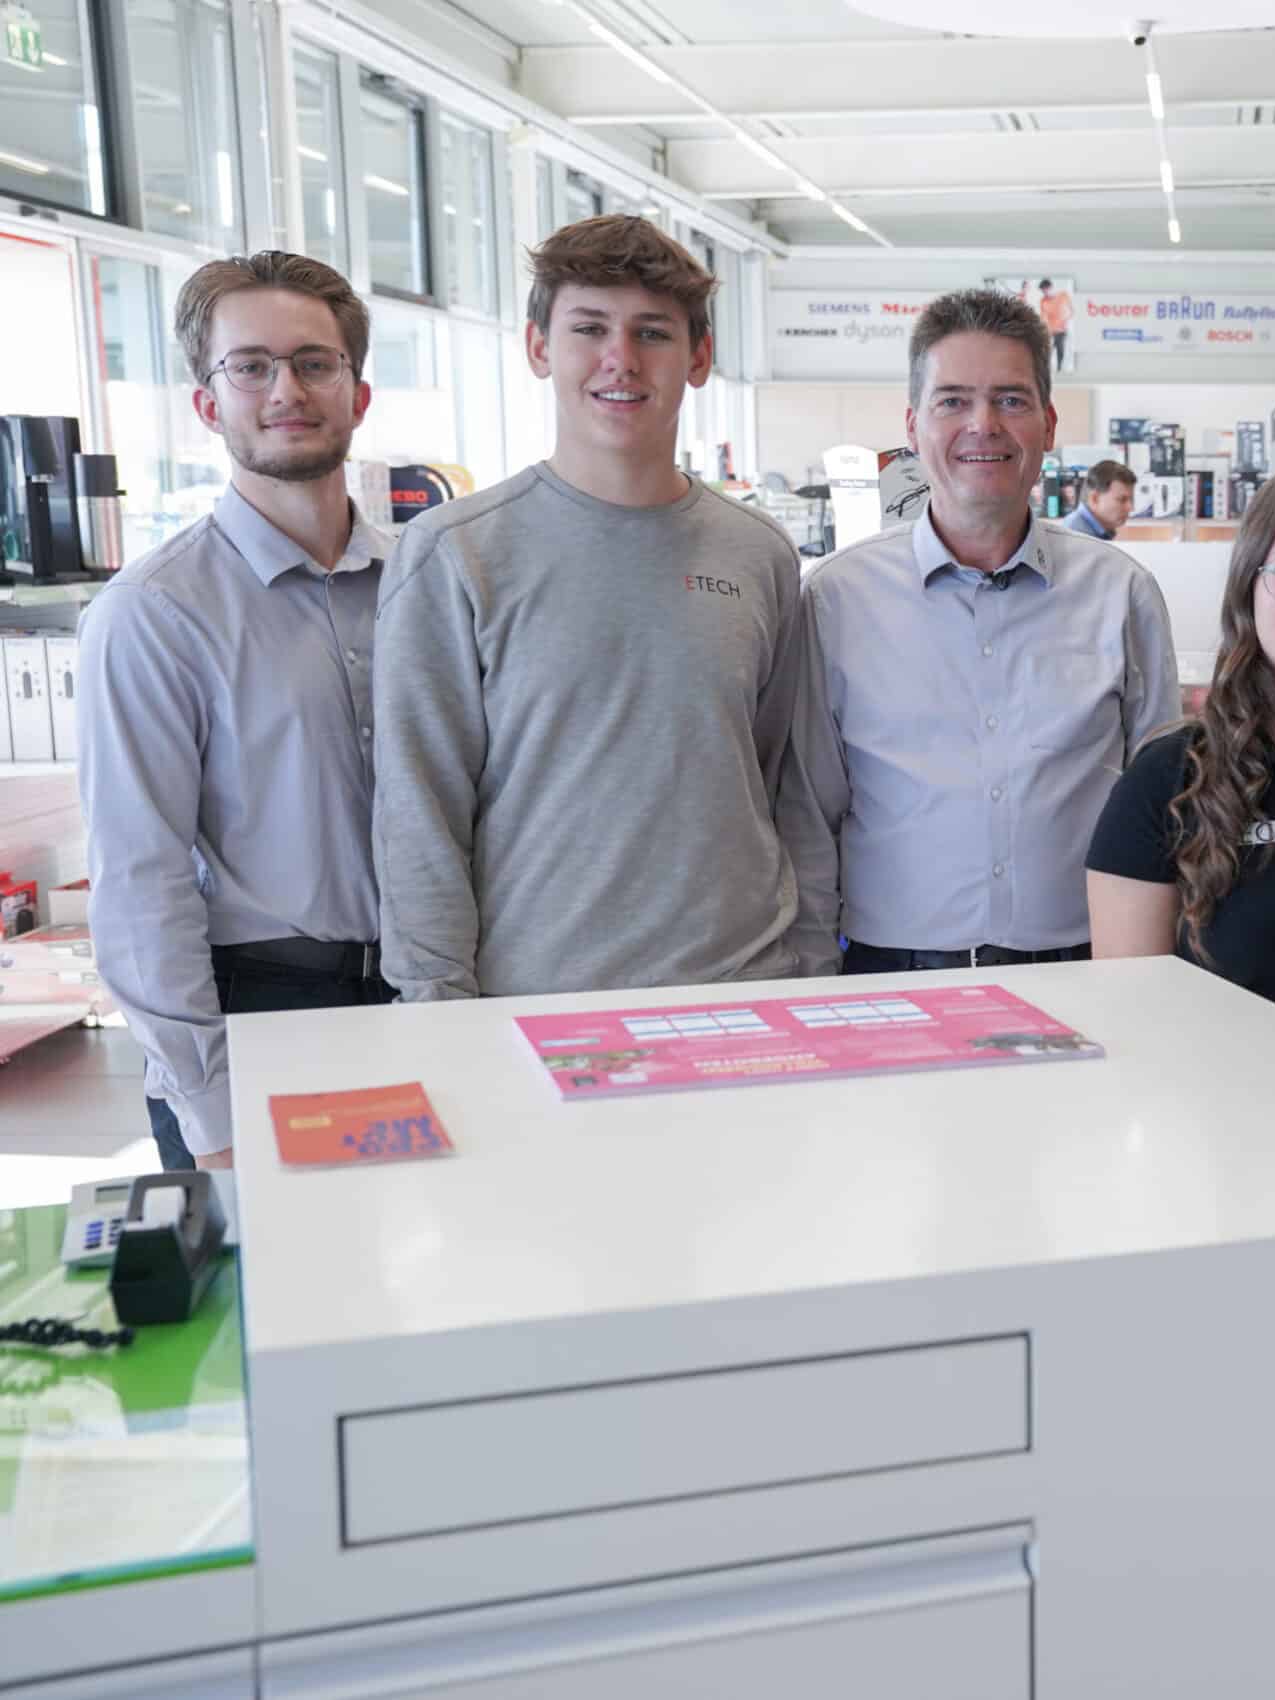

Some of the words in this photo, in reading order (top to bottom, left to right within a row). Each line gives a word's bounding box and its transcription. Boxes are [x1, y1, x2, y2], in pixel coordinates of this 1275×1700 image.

[1087, 300, 1149, 318] beurer
[1156, 296, 1216, 319] BRAUN
[843, 320, 904, 343] dyson
[1207, 329, 1253, 342] BOSCH
[684, 576, 741, 600] ETECH
